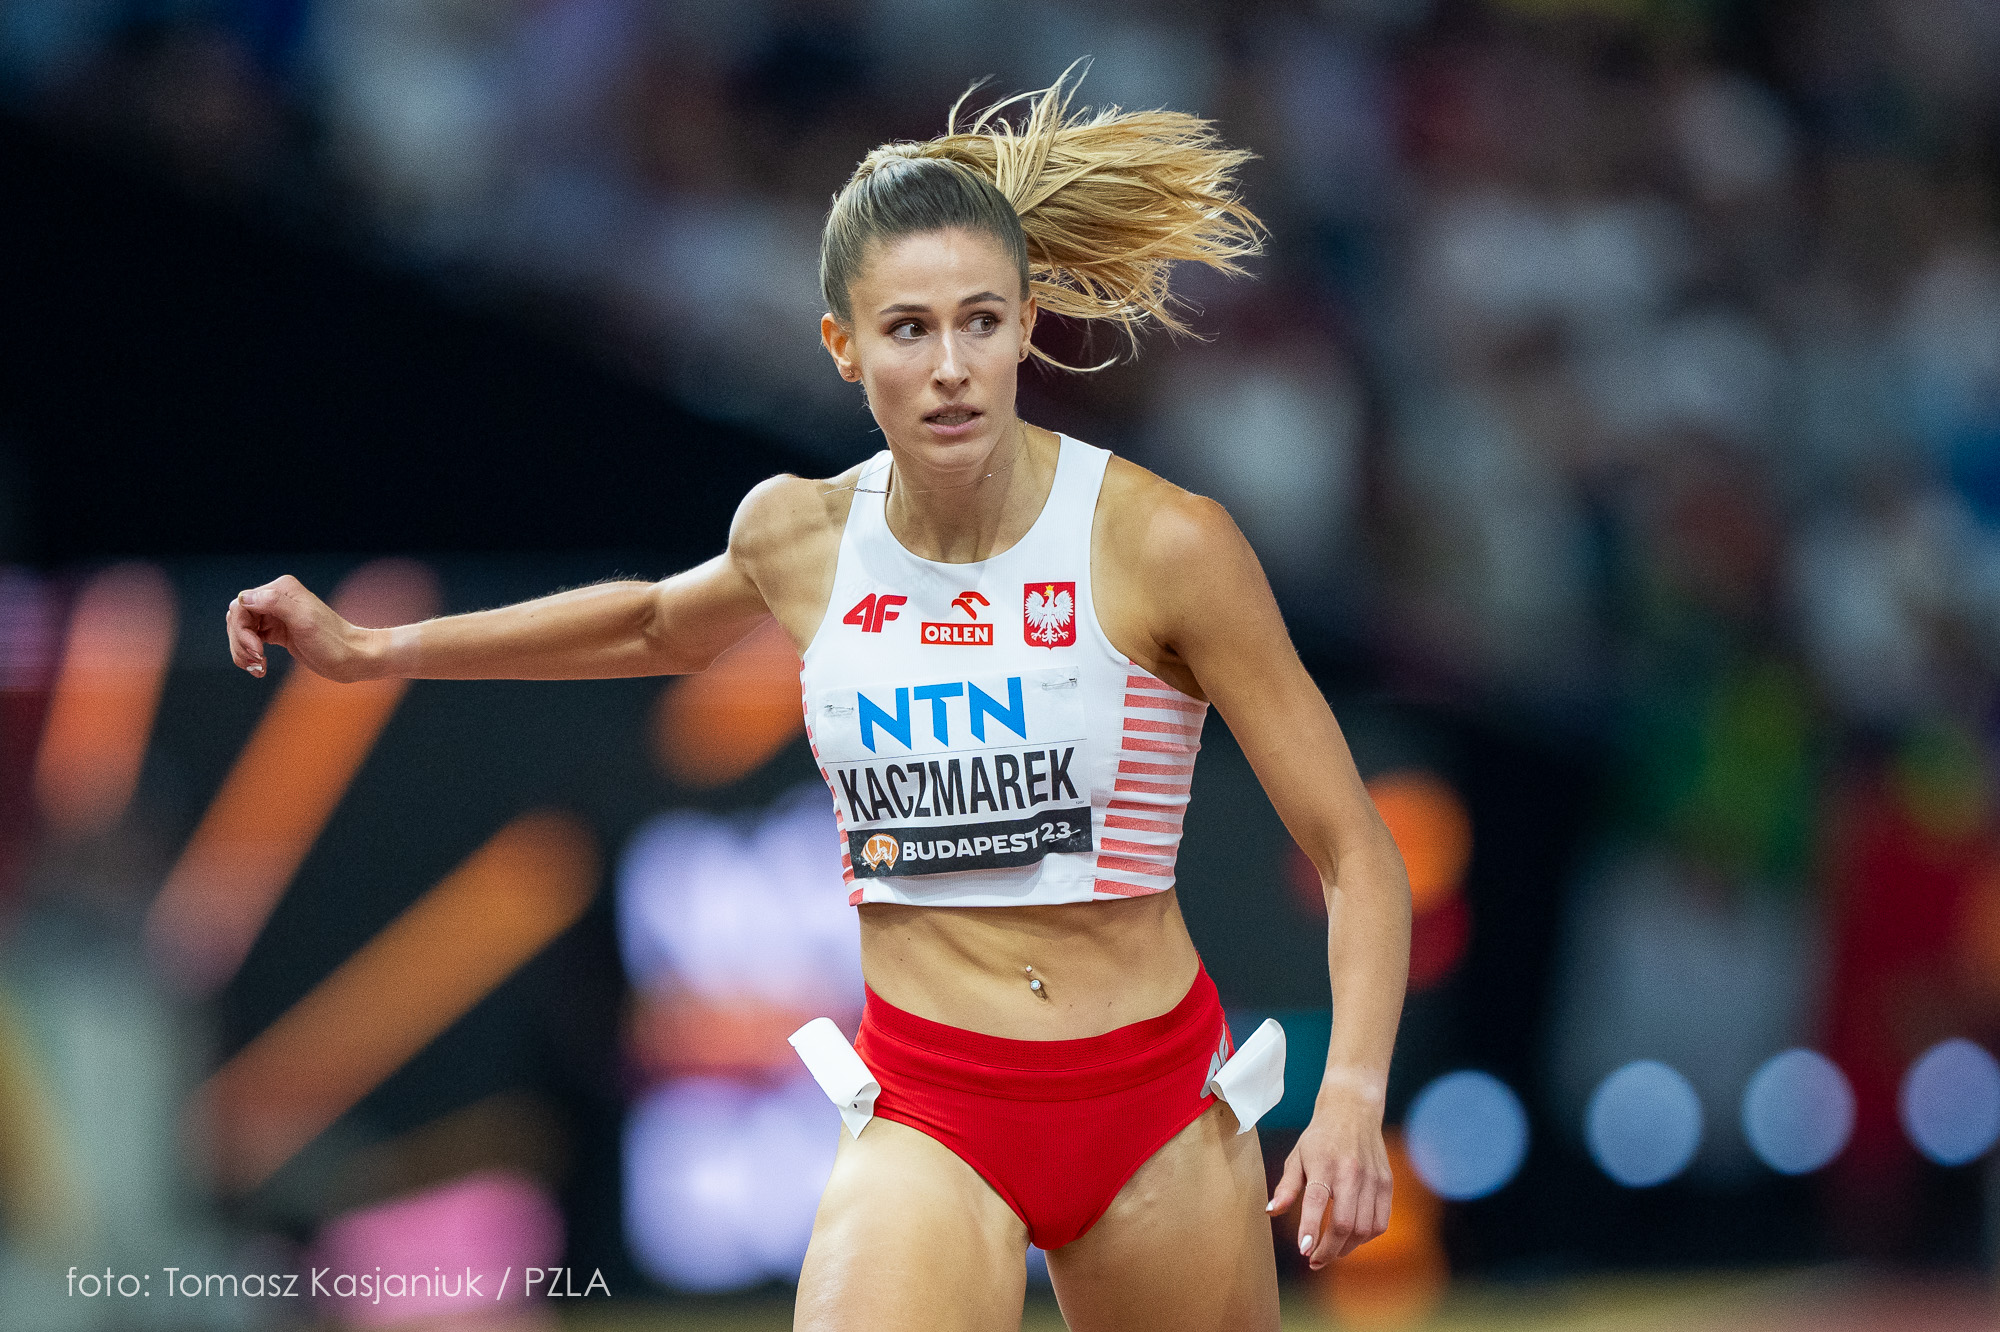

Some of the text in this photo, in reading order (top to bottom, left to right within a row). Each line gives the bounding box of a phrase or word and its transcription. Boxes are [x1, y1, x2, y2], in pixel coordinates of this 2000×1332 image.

[843, 592, 908, 633] 4F
[924, 625, 989, 643] ORLEN
[857, 676, 1027, 754] NTN
[838, 746, 1079, 823] KACZMAREK
[902, 828, 1039, 862] BUDAPEST
